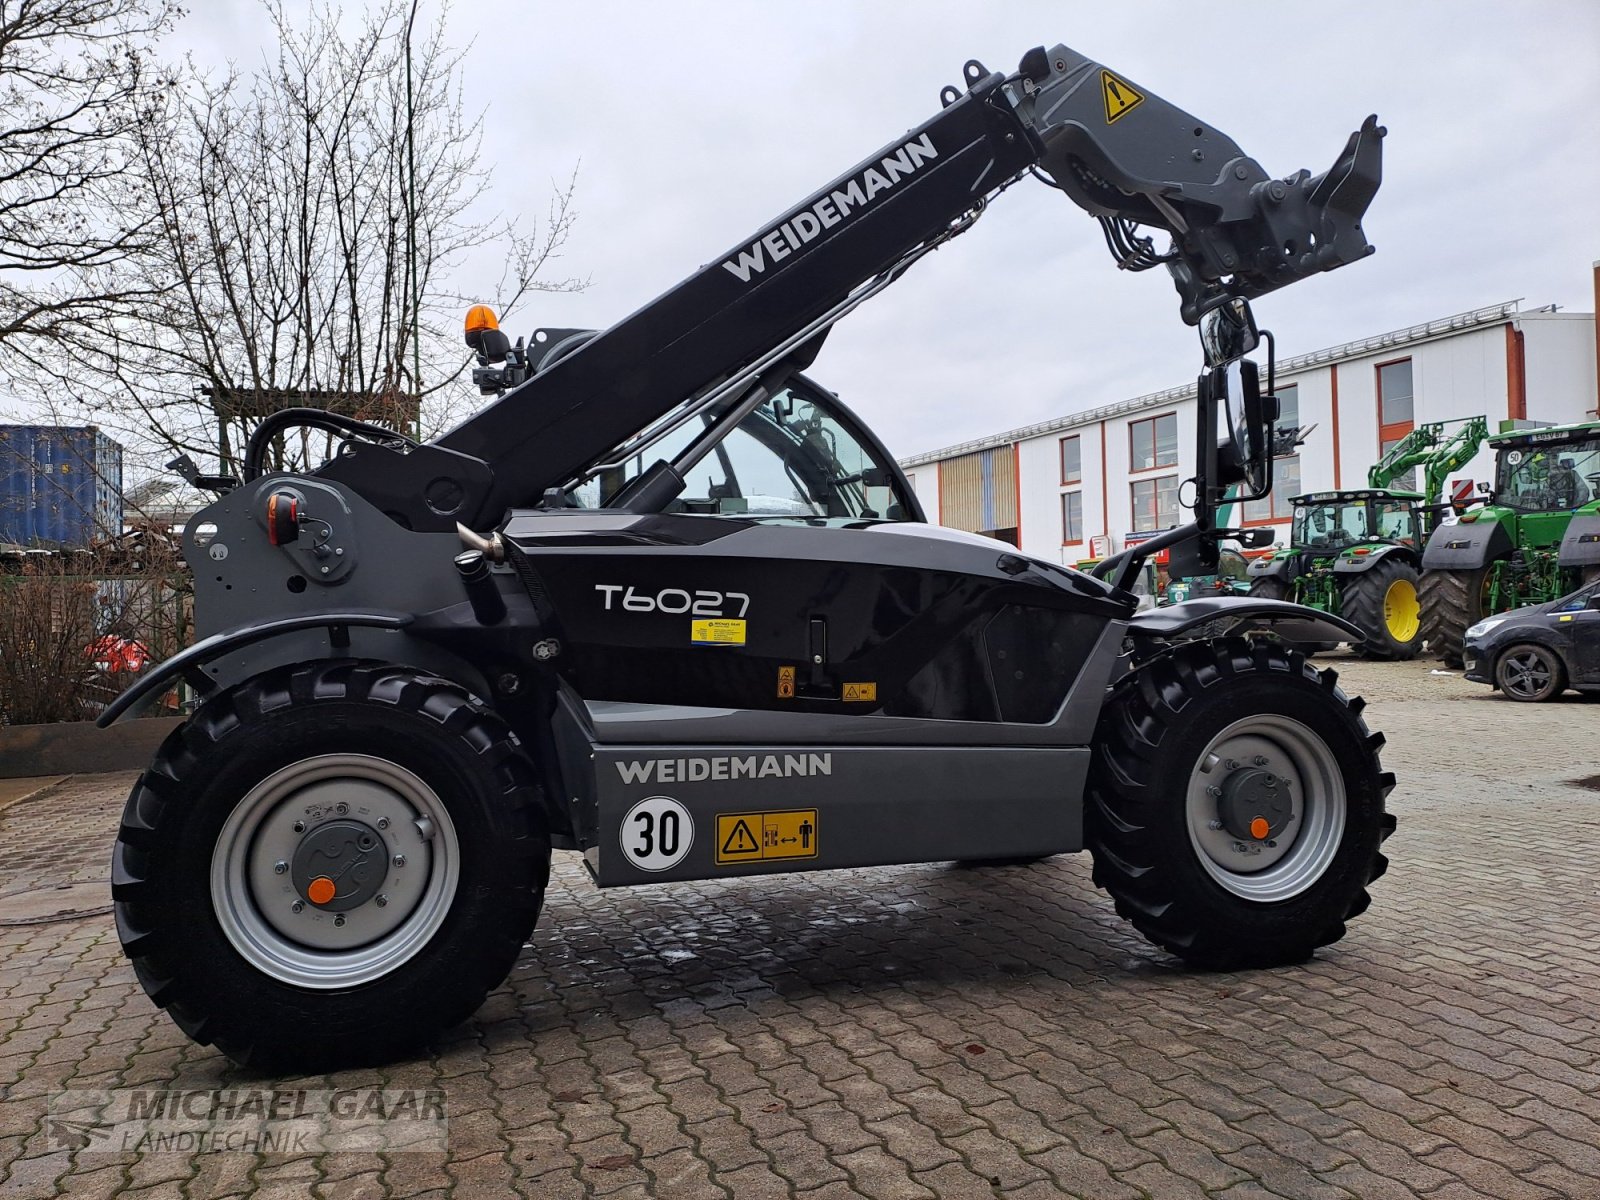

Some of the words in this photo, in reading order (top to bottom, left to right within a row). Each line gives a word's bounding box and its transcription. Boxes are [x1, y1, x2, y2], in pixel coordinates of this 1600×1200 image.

[722, 133, 938, 282] WEIDEMANN
[595, 584, 750, 617] T6027
[615, 753, 832, 784] WEIDEMANN
[633, 810, 680, 858] 30
